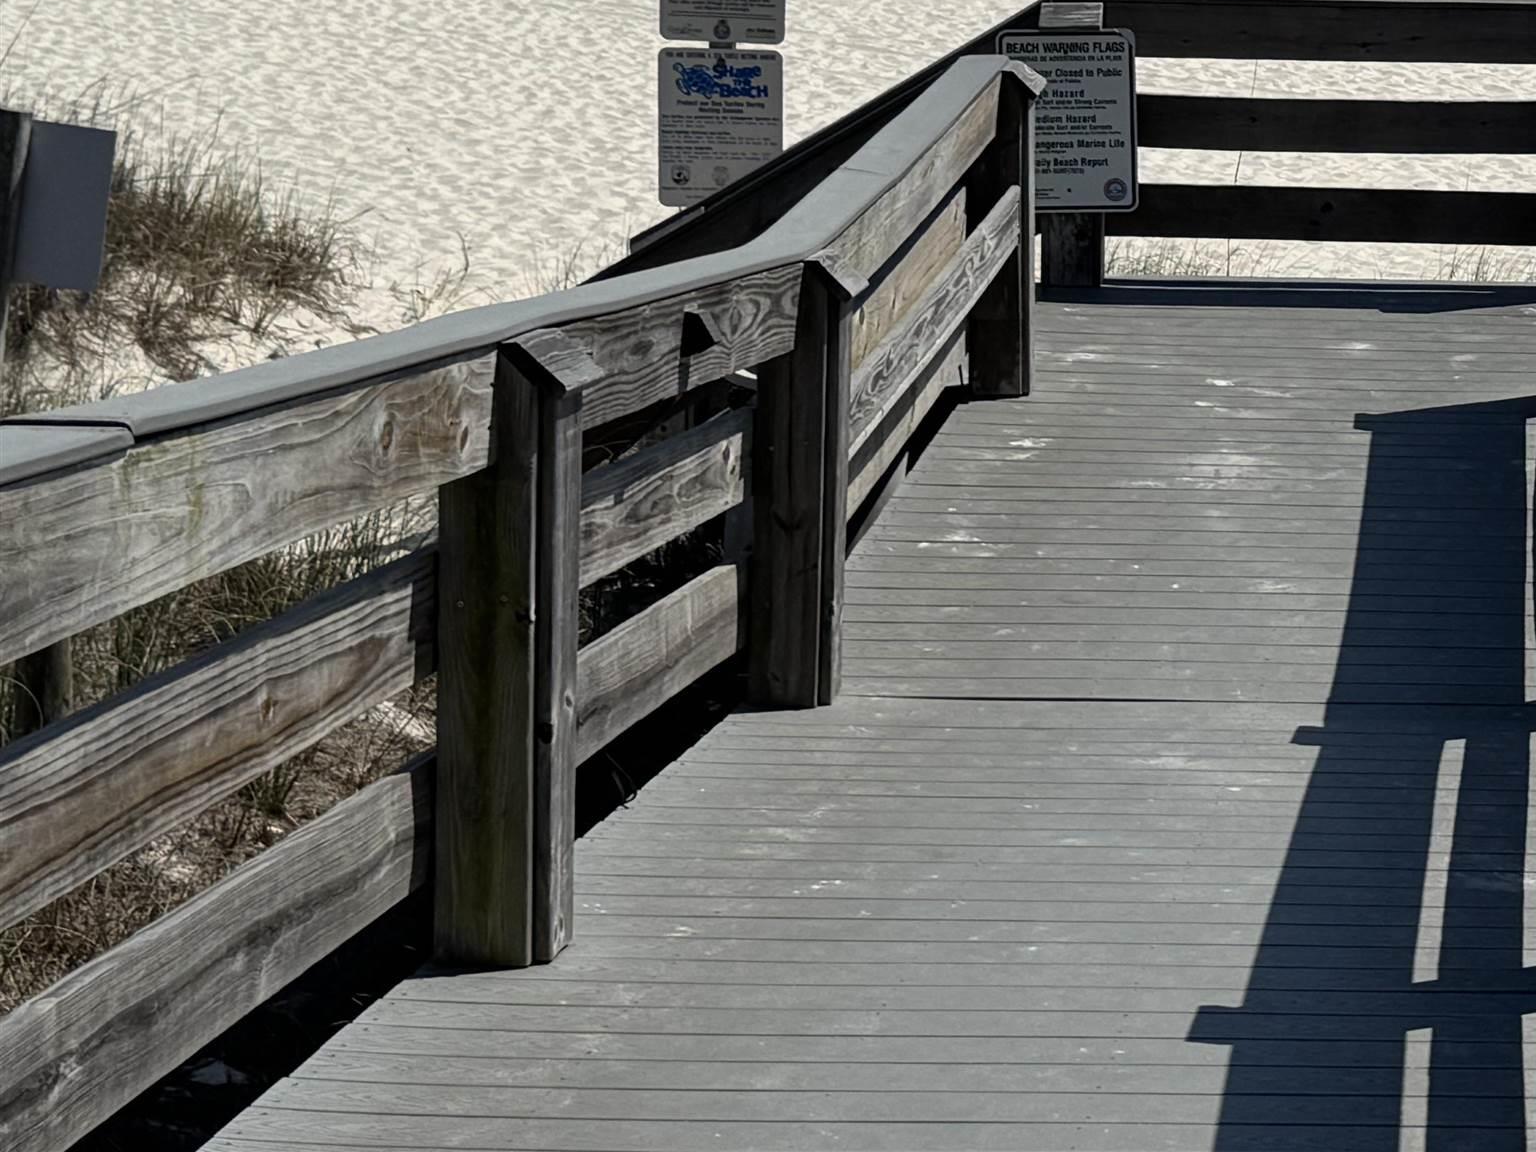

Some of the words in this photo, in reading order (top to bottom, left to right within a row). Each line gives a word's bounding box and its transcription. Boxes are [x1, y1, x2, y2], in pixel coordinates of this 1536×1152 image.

[1006, 42, 1039, 53] BEACH
[1042, 42, 1089, 53] WARNING
[1093, 42, 1125, 53] FLAGS
[1055, 69, 1083, 77] Closed
[1086, 69, 1093, 77] to
[1097, 69, 1122, 77] Public
[1052, 89, 1085, 98] Hazard
[1036, 115, 1062, 123] edium
[1066, 115, 1096, 123] Hazard
[1036, 141, 1074, 149] angerous
[1077, 139, 1106, 148] Marine
[1109, 139, 1125, 148] Life
[1035, 159, 1050, 167] aily
[1054, 158, 1078, 167] Beach
[1081, 158, 1108, 168] Report
